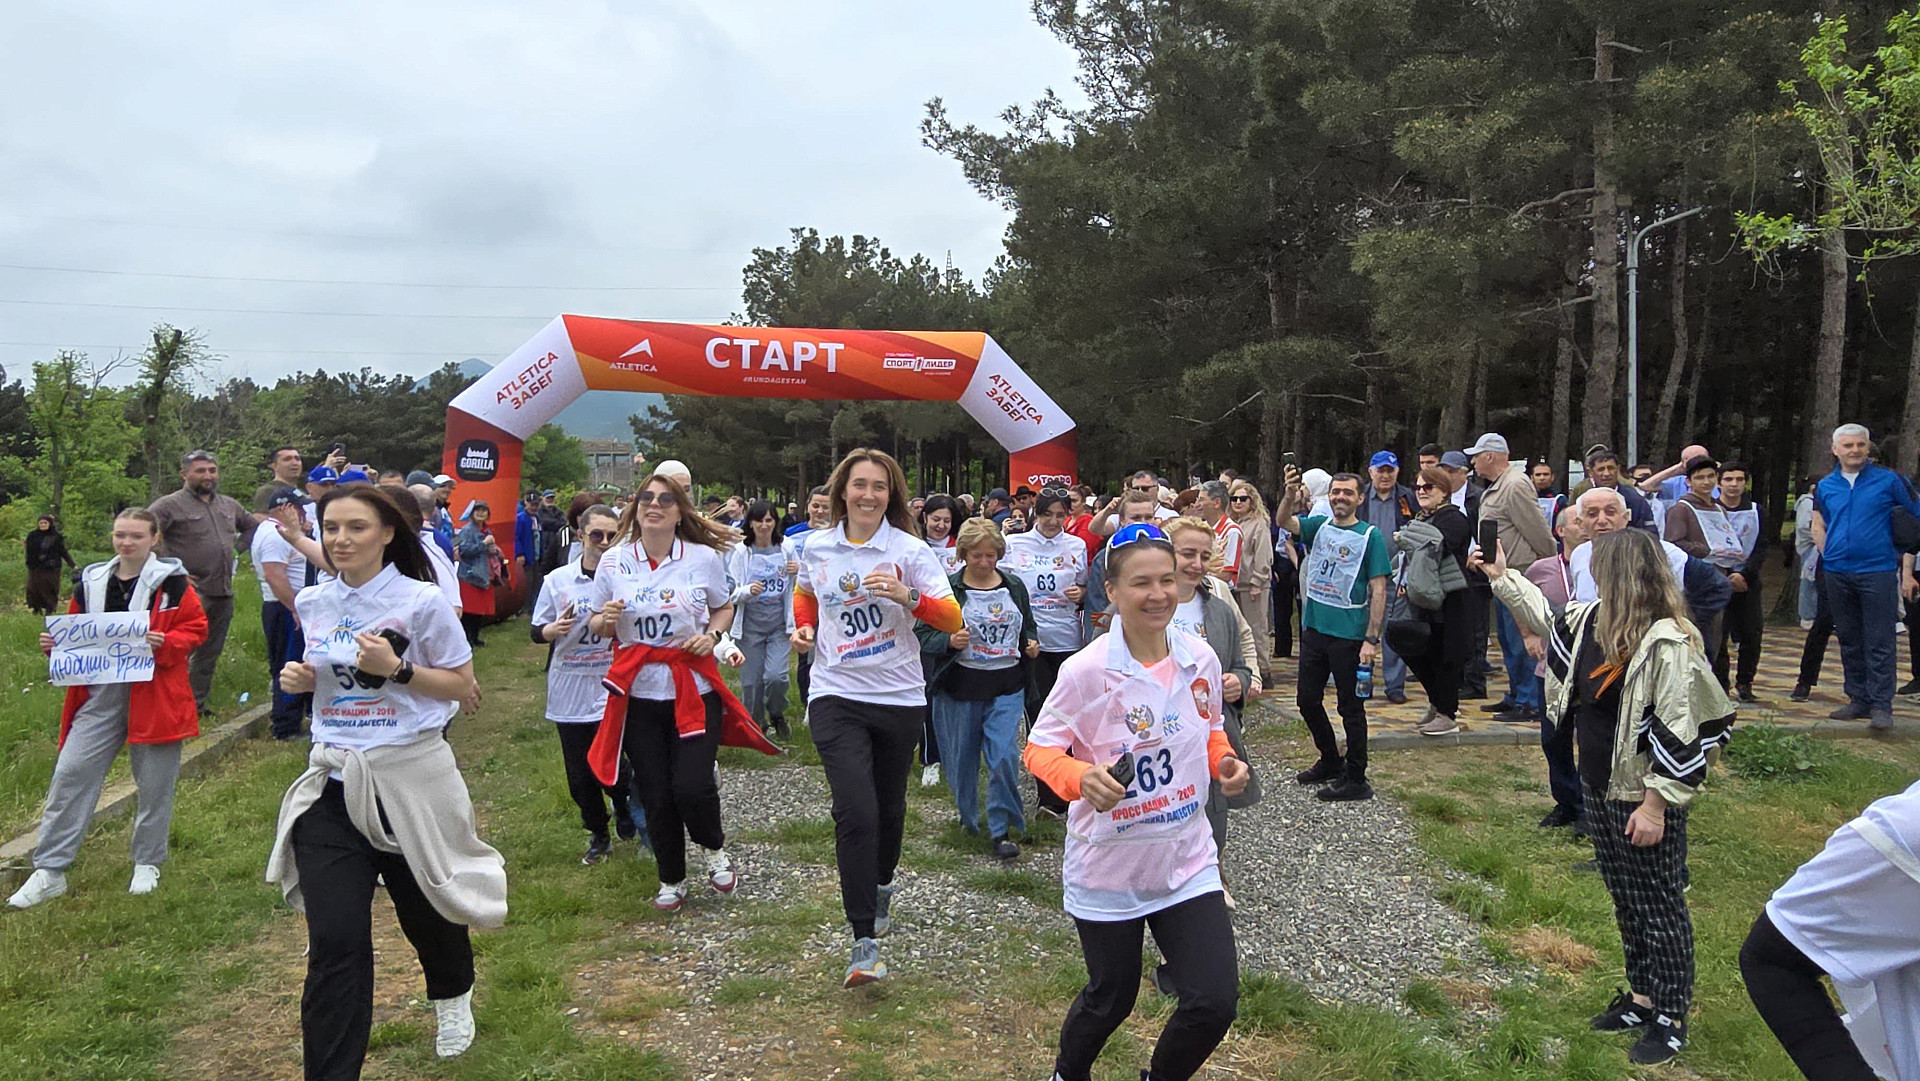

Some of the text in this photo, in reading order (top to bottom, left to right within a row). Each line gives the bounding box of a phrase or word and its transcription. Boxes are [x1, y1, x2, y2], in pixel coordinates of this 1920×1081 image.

[609, 362, 658, 372] ATLETICA
[705, 336, 845, 373] СТАРТ
[885, 359, 913, 367] СПОРТ
[925, 360, 954, 368] ЛИДЕР
[495, 352, 559, 404] ATLETICA
[510, 370, 554, 410] ЗАБЕГ
[743, 375, 807, 385] #RUNDAGESTAN
[986, 387, 1027, 422] ЗАБЕГ
[989, 374, 1043, 425] ATLETICA
[460, 457, 494, 470] GORILLA
[1320, 559, 1337, 578] 91
[1037, 573, 1056, 592] 63
[634, 613, 674, 640] 102
[840, 603, 883, 638] 300
[979, 623, 1009, 645] 337
[1112, 804, 1141, 821] КРОСС
[1141, 795, 1170, 814] НАЦИИ
